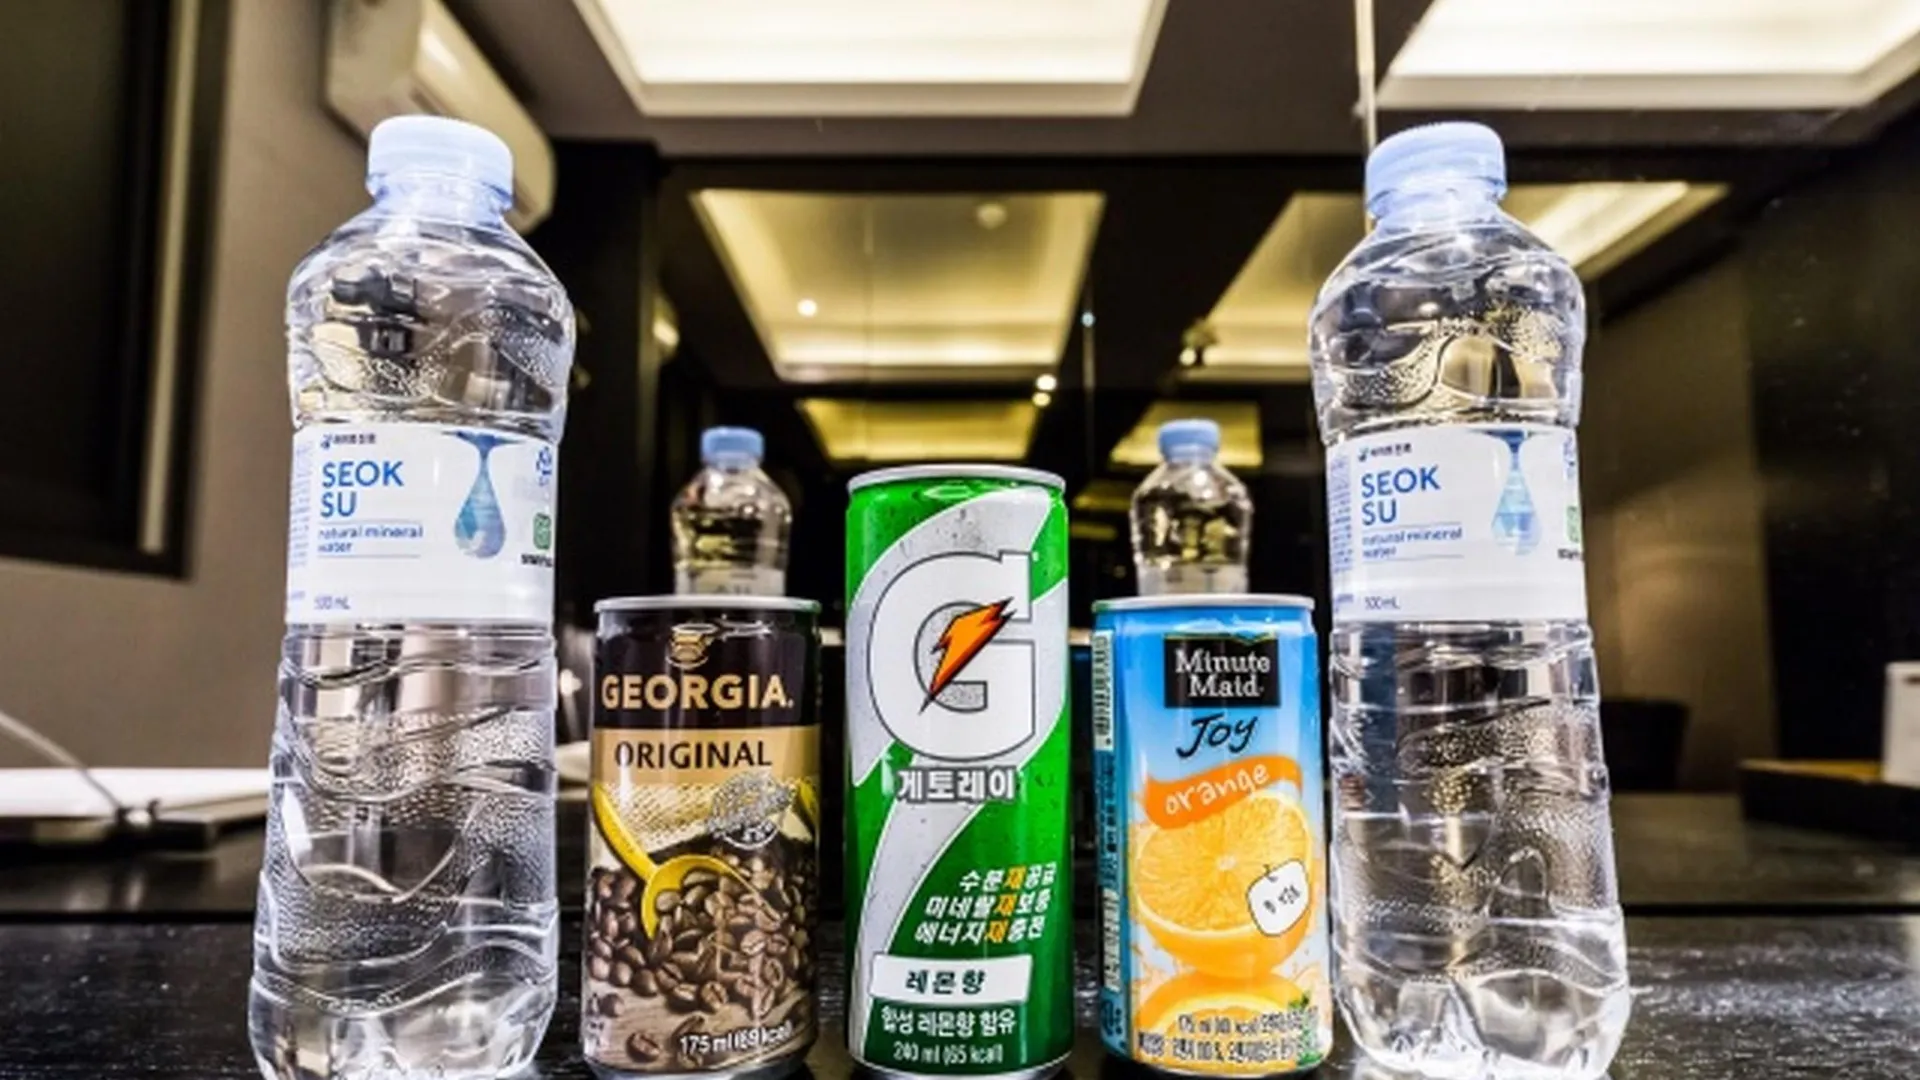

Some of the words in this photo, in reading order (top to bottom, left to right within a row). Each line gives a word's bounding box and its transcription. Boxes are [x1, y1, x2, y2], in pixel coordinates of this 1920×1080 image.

[321, 460, 404, 488] SEOK
[1361, 466, 1441, 498] SEOK
[320, 491, 357, 518] SU
[1361, 498, 1397, 526] SU
[318, 526, 362, 540] natural
[365, 525, 424, 538] mineral
[1362, 531, 1405, 546] natural
[1407, 527, 1462, 541] mineral
[867, 551, 1035, 762] G
[1175, 649, 1271, 674] Minute
[602, 674, 788, 710] GEORGIA
[1188, 674, 1261, 698] Maid
[1175, 712, 1259, 759] Joy
[614, 740, 773, 769] ORIGINAL
[896, 766, 1018, 803] 게토레이
[1165, 763, 1270, 816] orange
[906, 969, 986, 995] 레몬향
[917, 1010, 976, 1038] 레몬향
[980, 1008, 1016, 1037] 함유
[680, 1034, 710, 1054] 175
